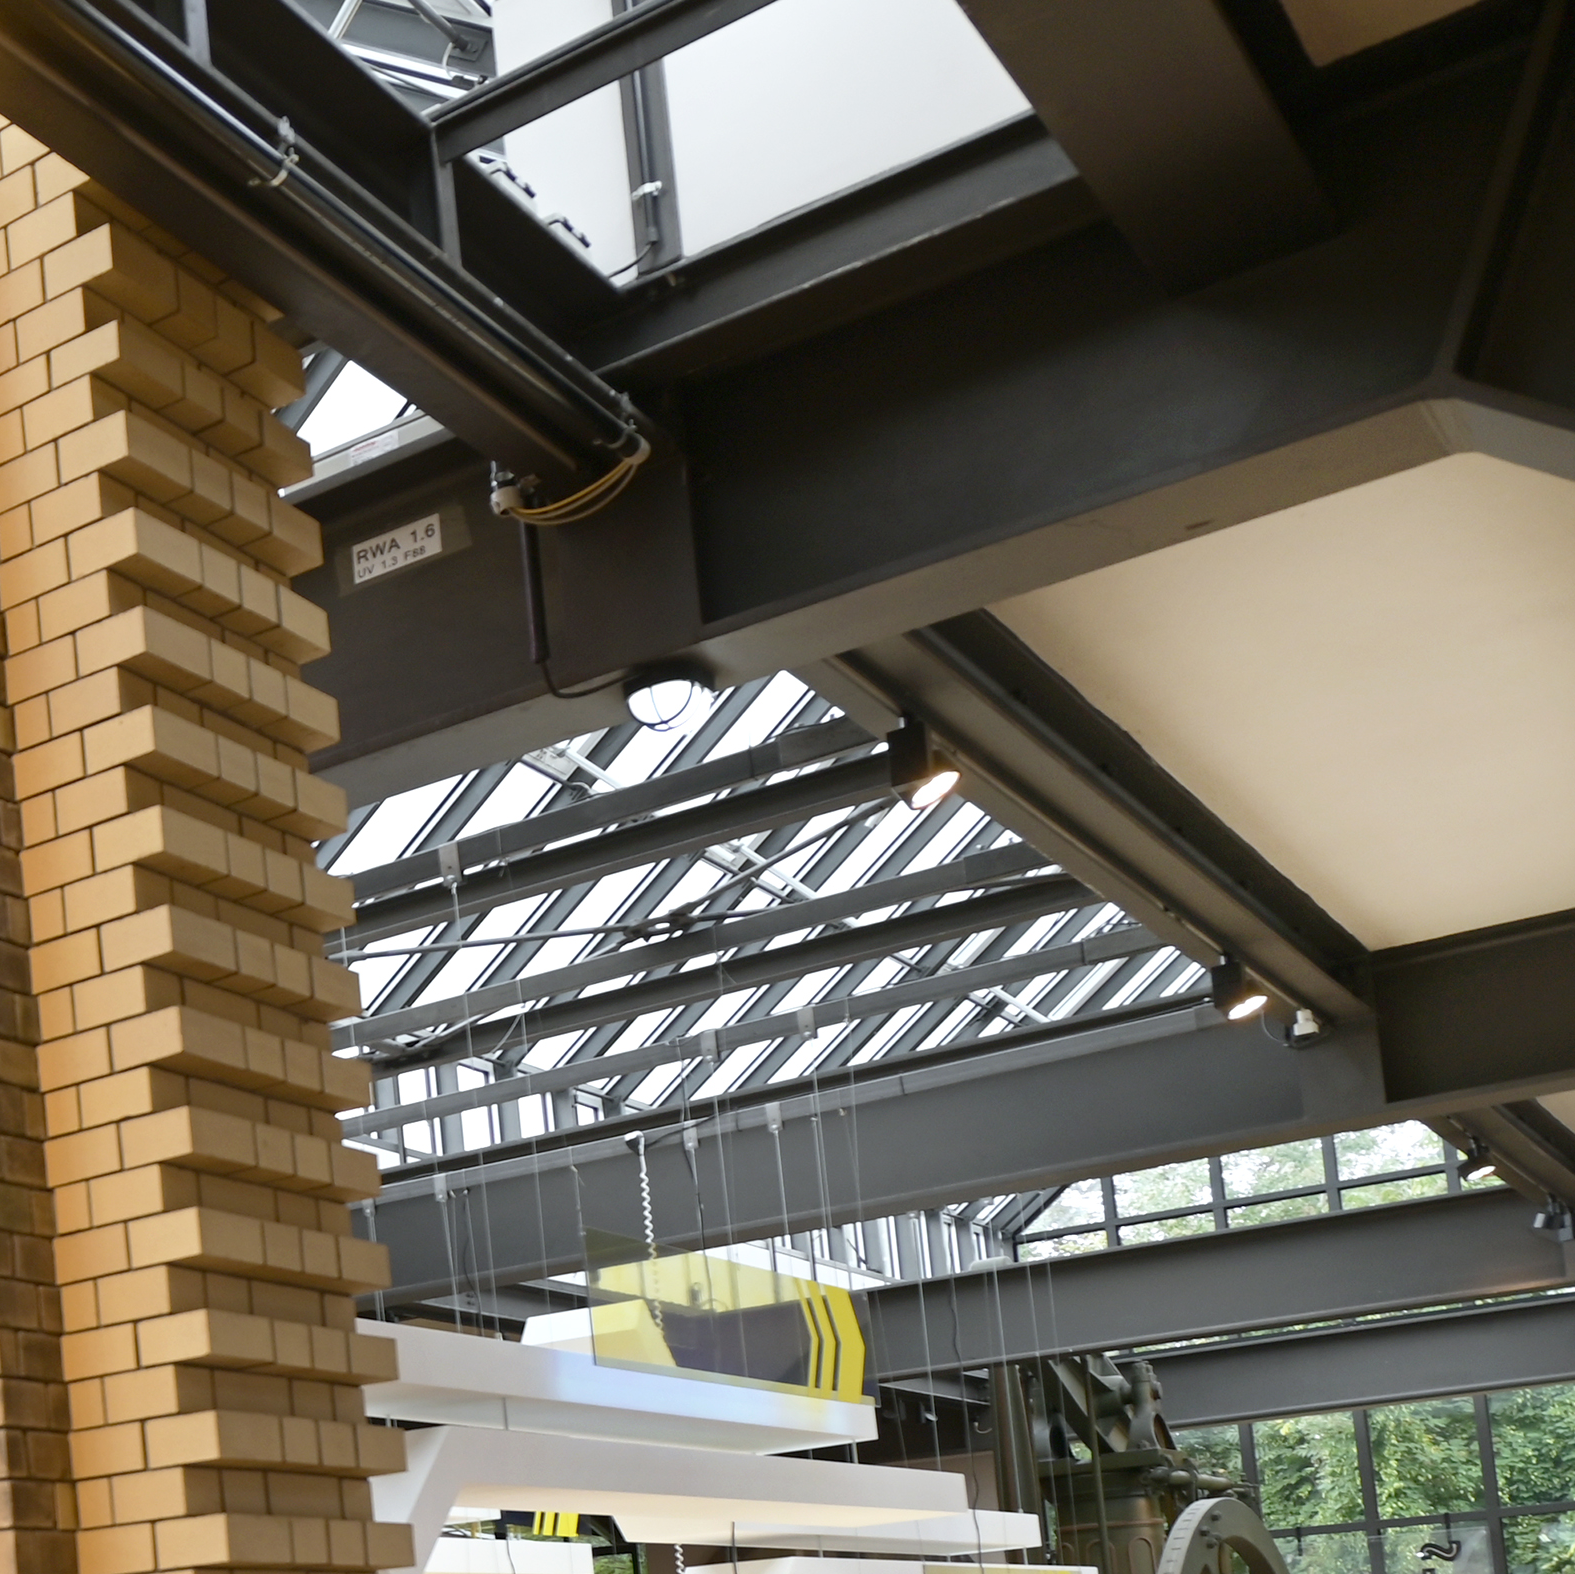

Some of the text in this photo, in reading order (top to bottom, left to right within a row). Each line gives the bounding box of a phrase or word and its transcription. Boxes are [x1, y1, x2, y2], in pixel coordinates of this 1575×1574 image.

[357, 523, 435, 564] RWA 1.6
[357, 563, 375, 578] UV
